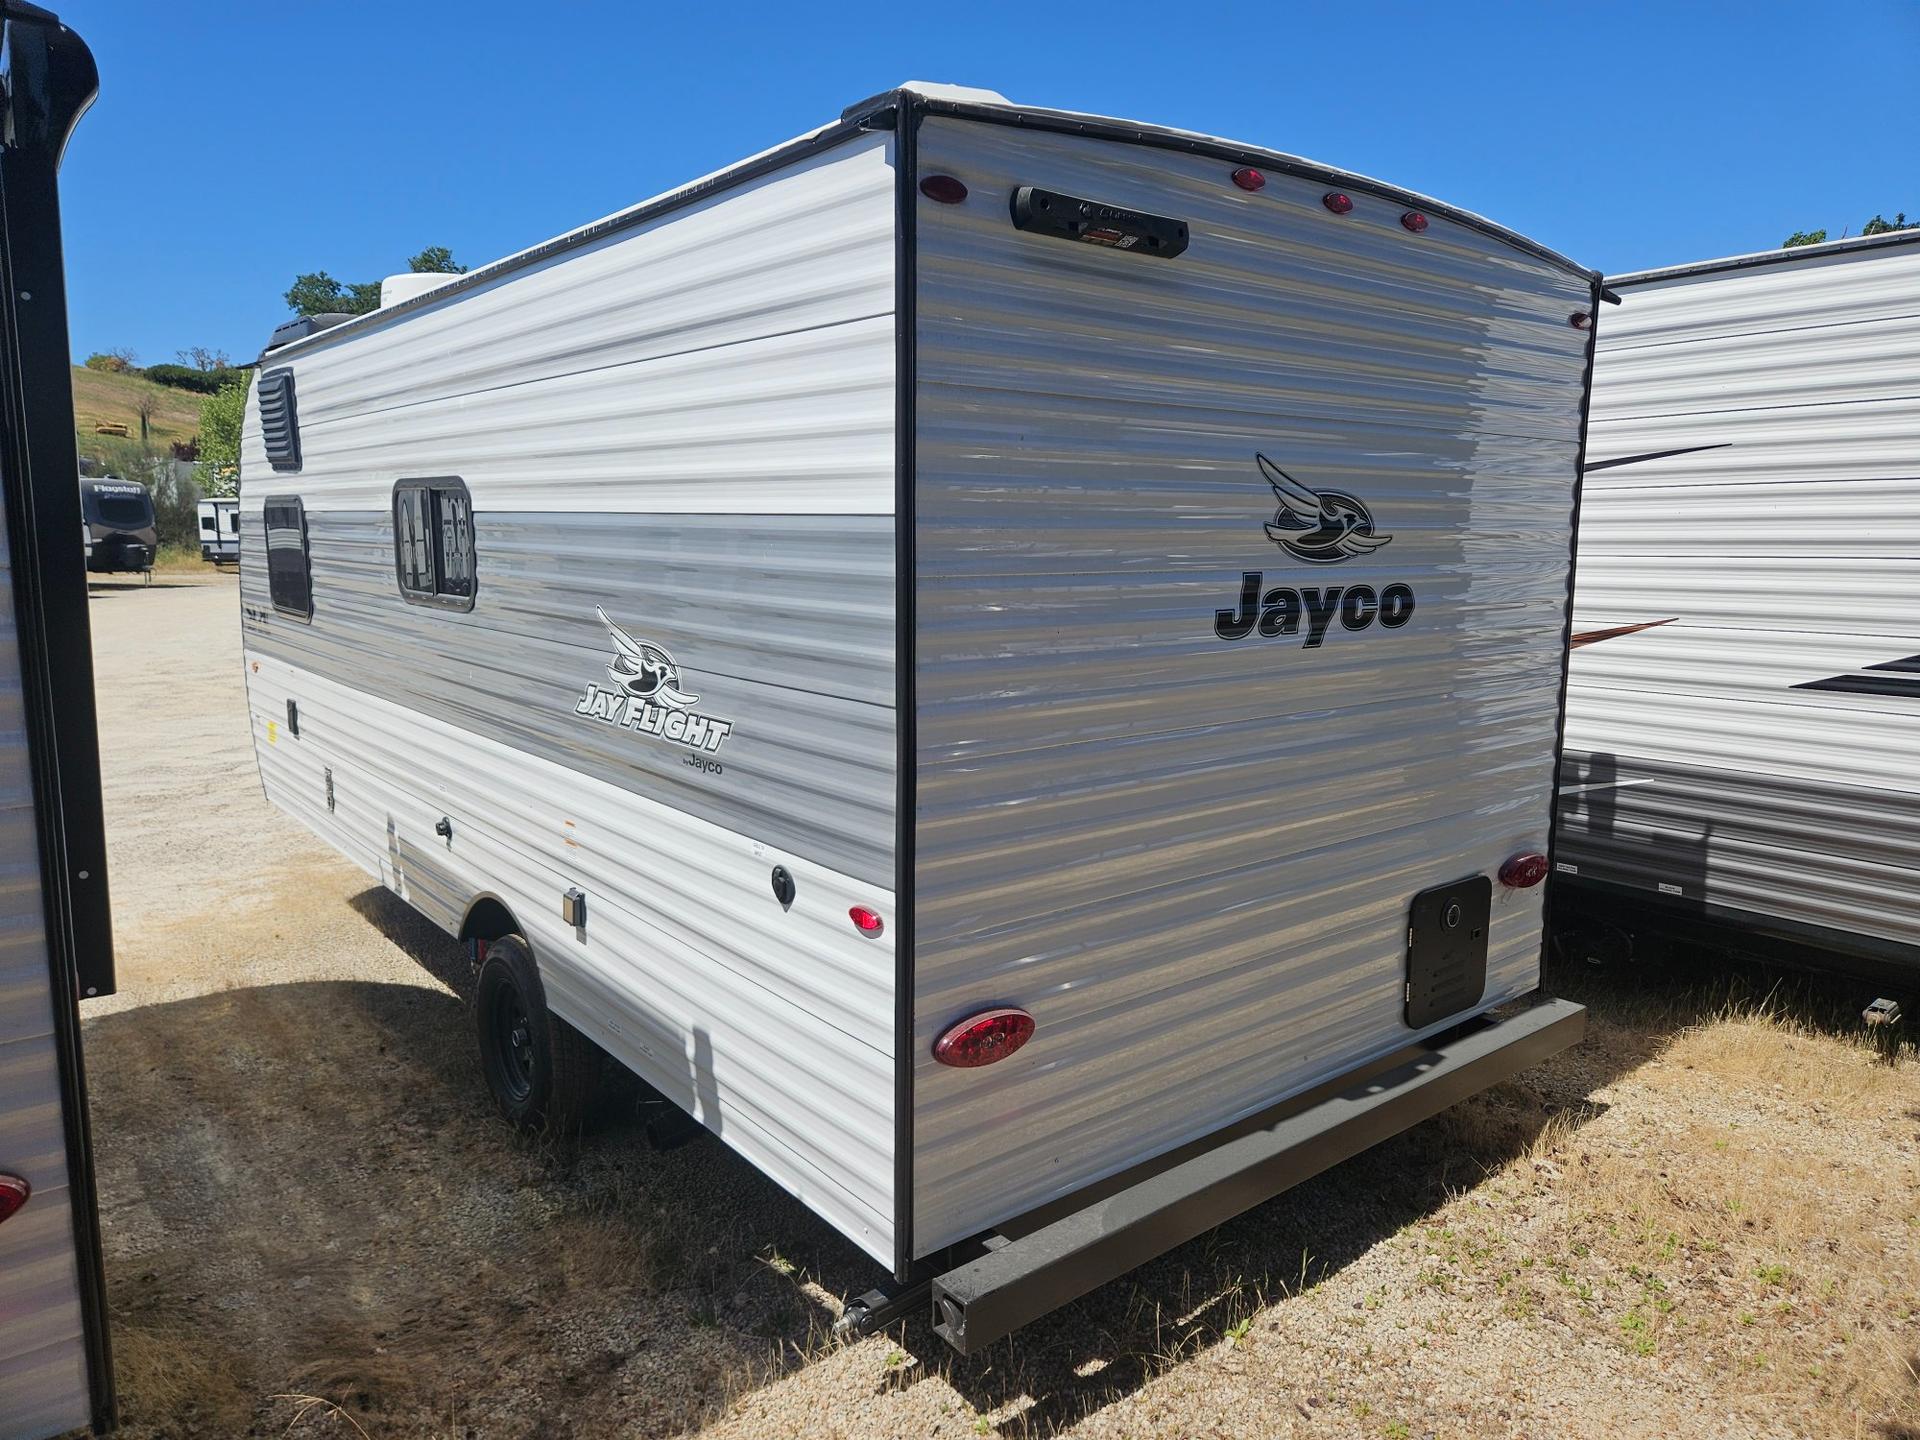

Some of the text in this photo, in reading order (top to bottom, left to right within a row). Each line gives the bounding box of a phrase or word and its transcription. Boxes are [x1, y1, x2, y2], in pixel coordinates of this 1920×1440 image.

[94, 484, 141, 495] Flagstaff
[1214, 571, 1416, 649] Jayco
[575, 681, 735, 754] JAY FLIGHT
[689, 753, 723, 775] Jayco
